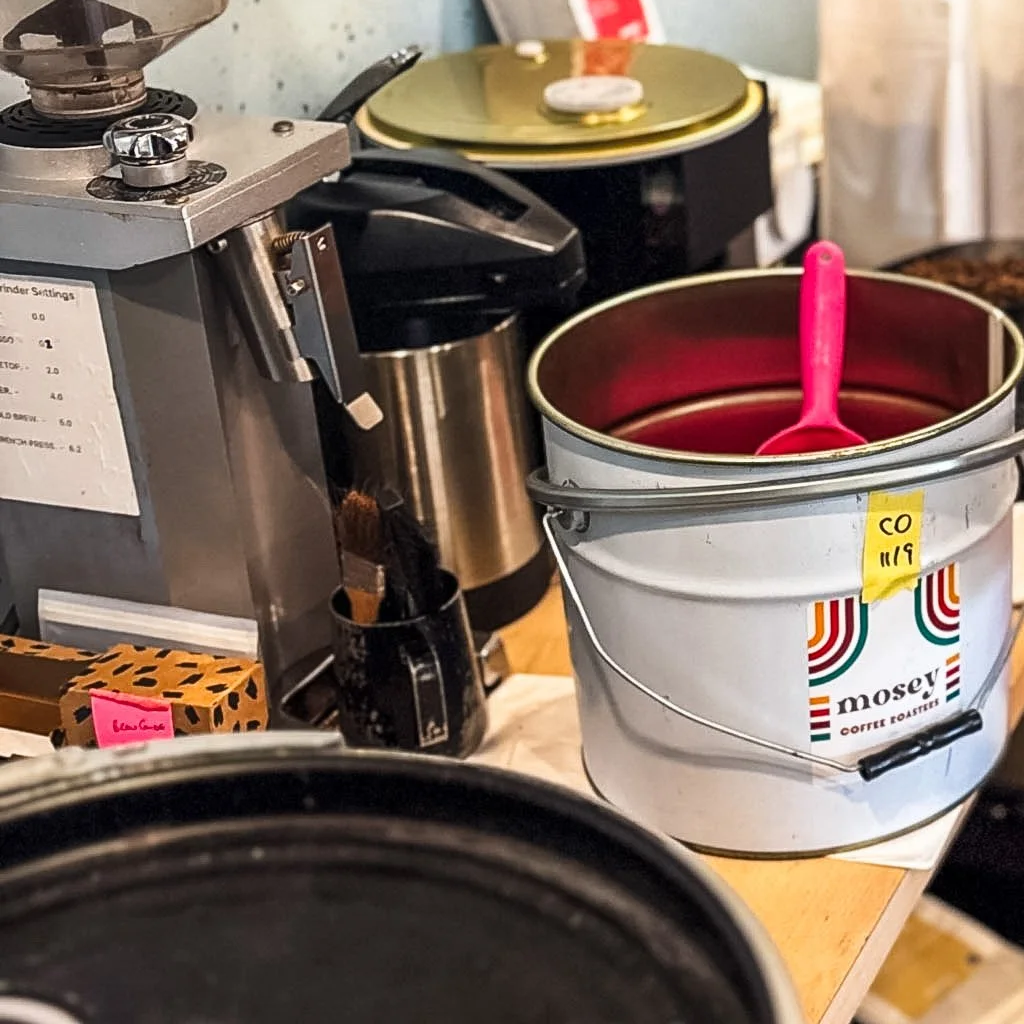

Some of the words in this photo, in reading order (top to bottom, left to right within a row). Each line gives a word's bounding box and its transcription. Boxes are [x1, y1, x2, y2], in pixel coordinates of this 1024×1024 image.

[31, 287, 75, 302] Settings
[31, 312, 46, 322] 0.0
[46, 366, 60, 375] 2.0
[879, 513, 912, 536] CO
[879, 542, 914, 567] 11/9
[837, 666, 941, 715] mosey
[840, 717, 886, 737] COFFEE
[890, 698, 940, 725] ROASTERS
